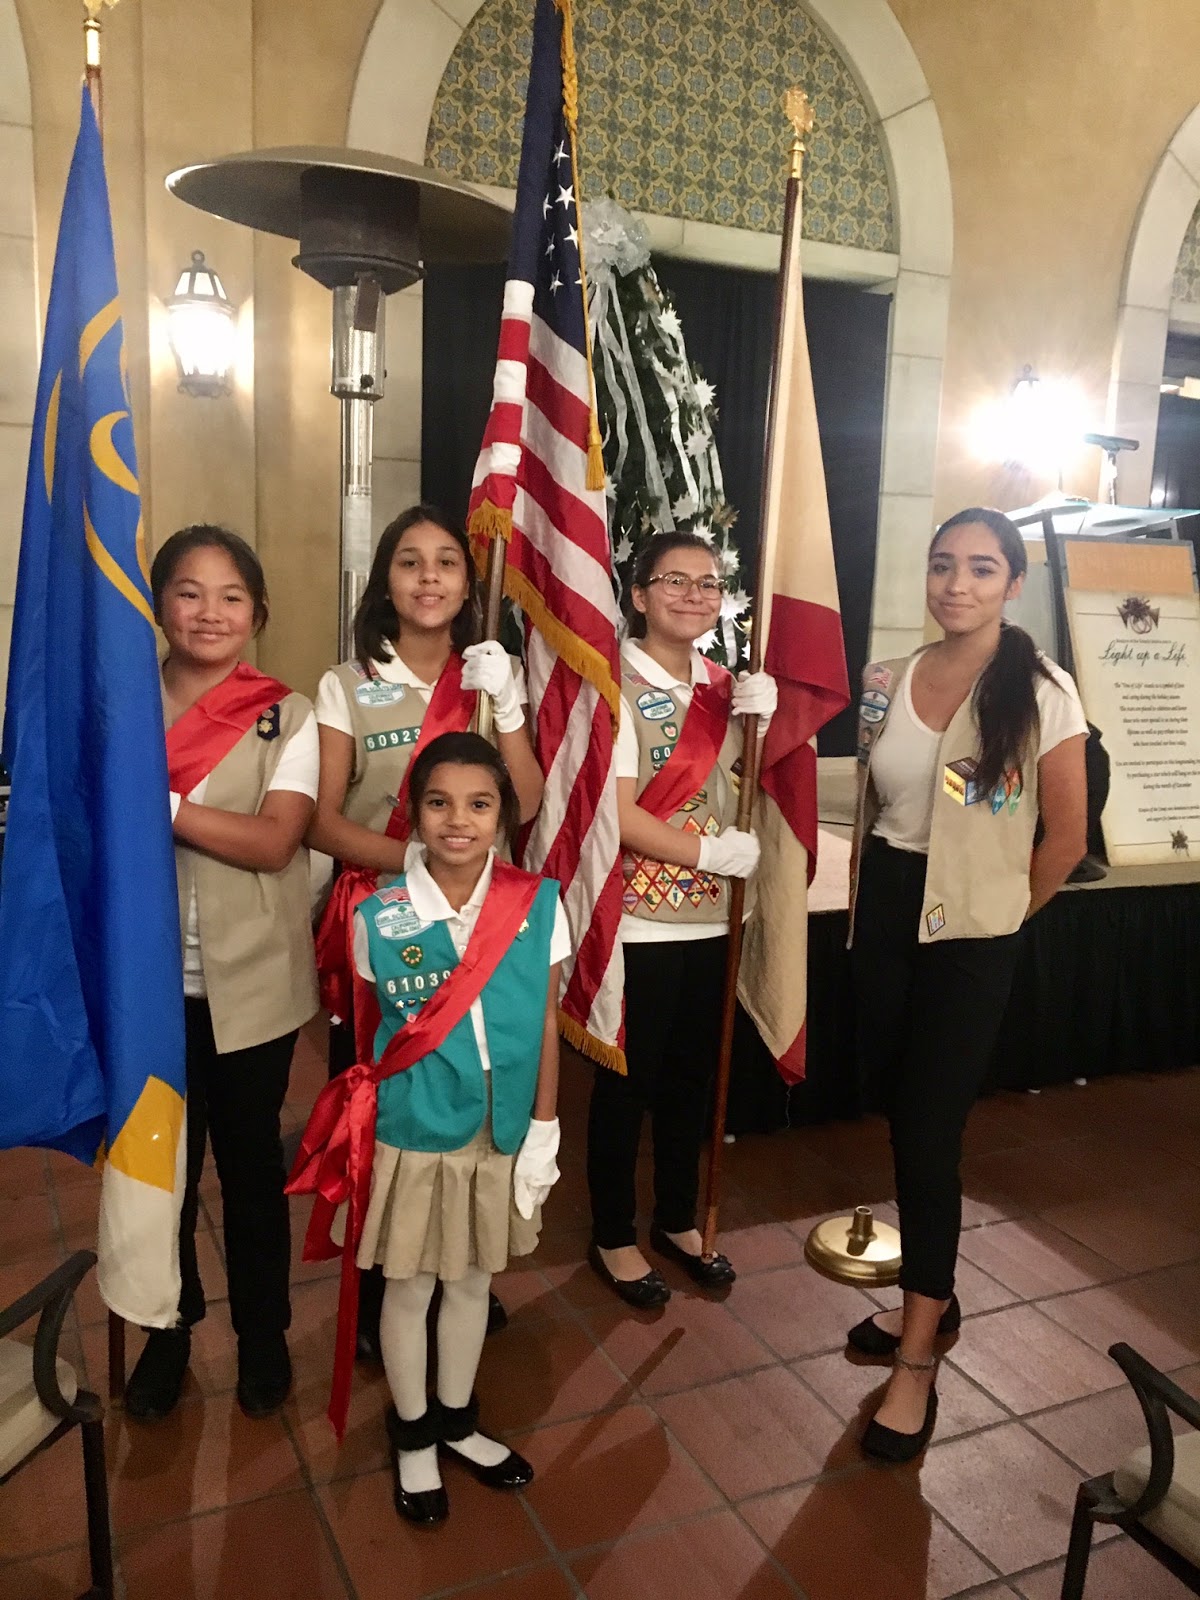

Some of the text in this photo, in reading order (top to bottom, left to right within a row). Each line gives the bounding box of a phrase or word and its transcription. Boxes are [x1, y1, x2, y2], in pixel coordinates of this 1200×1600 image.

[1098, 640, 1187, 667] Light up a Life
[366, 728, 421, 749] 60923
